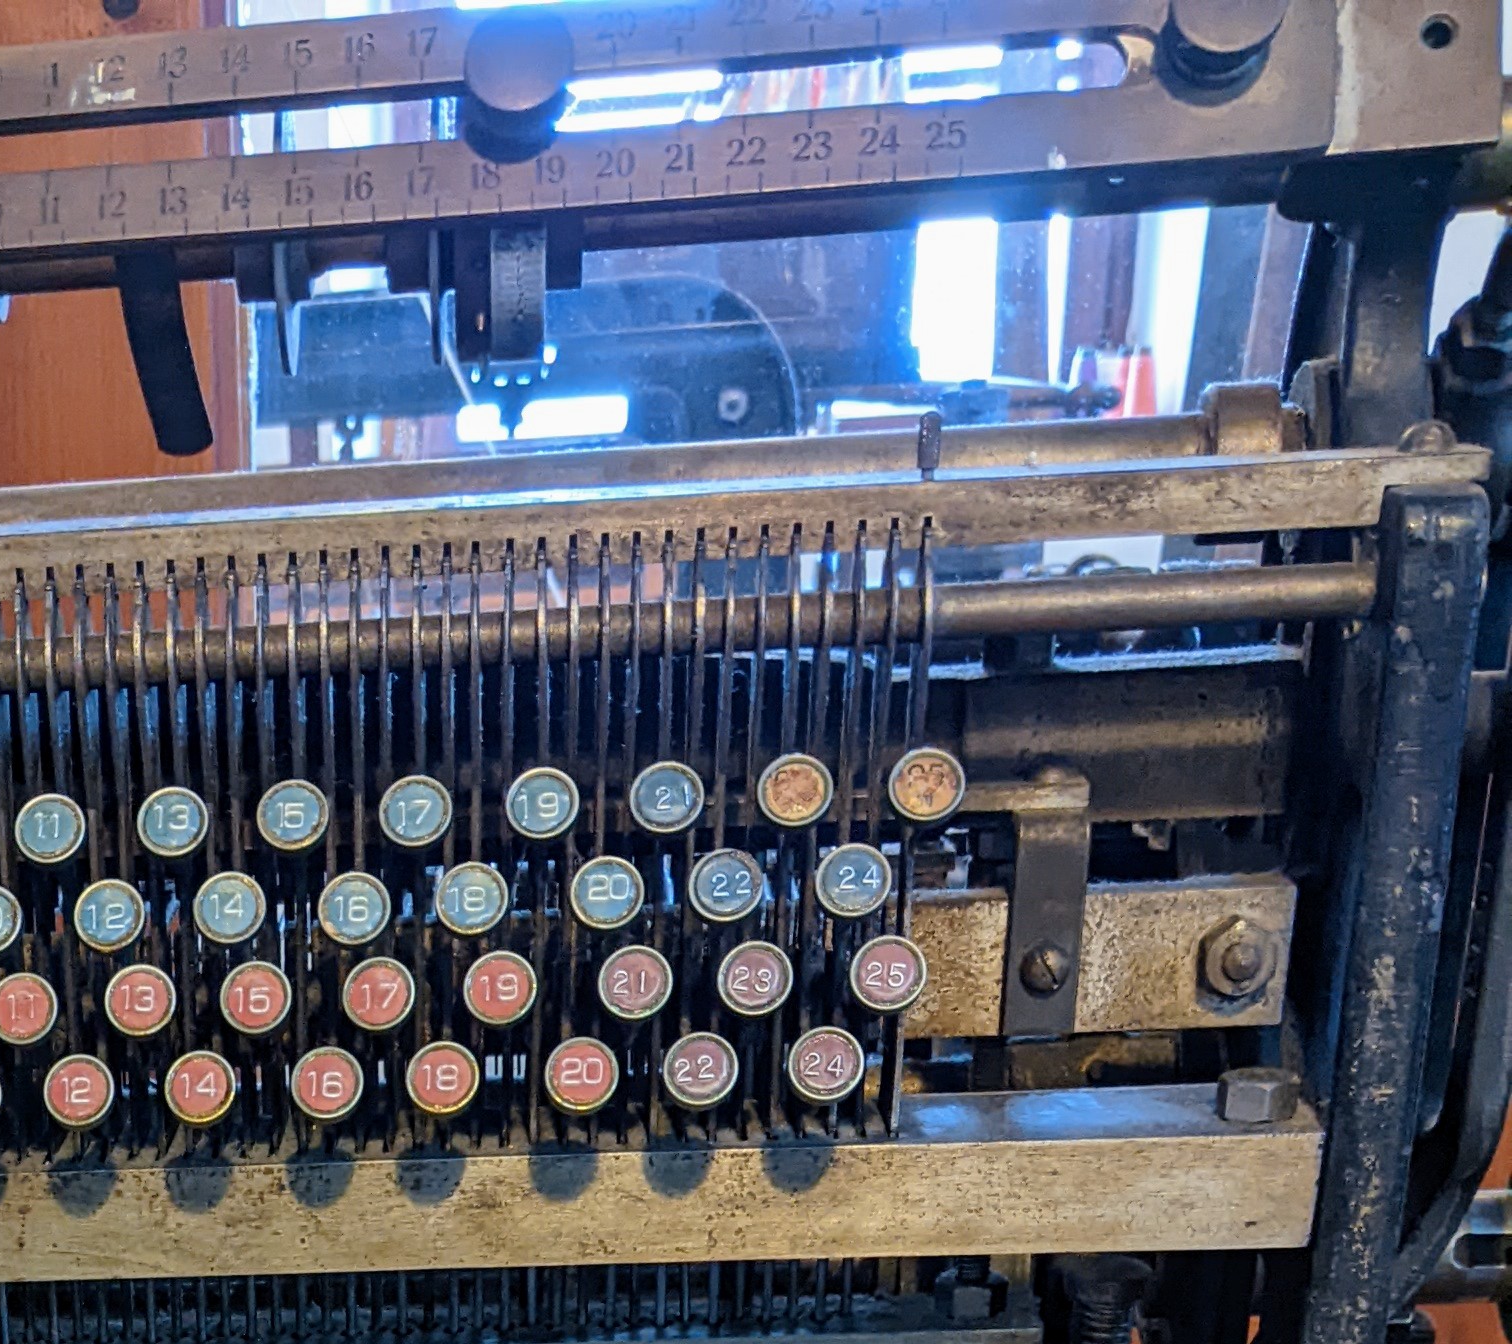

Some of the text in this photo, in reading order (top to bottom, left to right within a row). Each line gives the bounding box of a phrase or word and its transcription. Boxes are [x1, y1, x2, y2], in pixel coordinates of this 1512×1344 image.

[158, 43, 188, 80] 13
[221, 44, 251, 74] 14
[283, 39, 313, 69] 15
[344, 32, 375, 64] 16
[407, 26, 438, 58] 17
[40, 195, 60, 226] 11
[98, 189, 128, 221] 12
[158, 185, 188, 216] 13
[221, 178, 251, 212] 14
[284, 176, 314, 208] 15
[344, 170, 374, 202] 16
[406, 165, 435, 197] 17
[470, 161, 501, 190] 18
[535, 154, 566, 186] 19
[596, 147, 637, 179] 20
[664, 142, 695, 173] 21
[726, 136, 767, 167] 22
[792, 130, 834, 162] 23
[859, 124, 900, 156] 24
[925, 119, 967, 150] 25
[33, 811, 61, 839] 11
[152, 803, 188, 831] 13
[277, 801, 306, 829] 15
[397, 798, 432, 827] 17
[515, 791, 559, 820] 19
[655, 783, 690, 811] 21
[87, 902, 127, 930] 12
[209, 893, 244, 921] 14
[334, 894, 369, 922] 16
[448, 886, 486, 913] 18
[585, 872, 631, 901] 20
[711, 870, 752, 897] 22
[838, 865, 880, 891] 24
[7, 993, 36, 1021] 11
[120, 985, 155, 1012] 13
[234, 986, 271, 1013] 15
[361, 981, 399, 1009] 17
[479, 973, 519, 1001] 19
[612, 969, 647, 996] 21
[732, 965, 771, 992] 23
[865, 961, 907, 987] 25
[60, 1076, 91, 1104] 12
[179, 1071, 217, 1098] 14
[307, 1070, 343, 1098] 16
[421, 1064, 459, 1091] 18
[560, 1057, 604, 1084] 20
[675, 1055, 716, 1082] 22
[803, 1052, 844, 1078] 24
